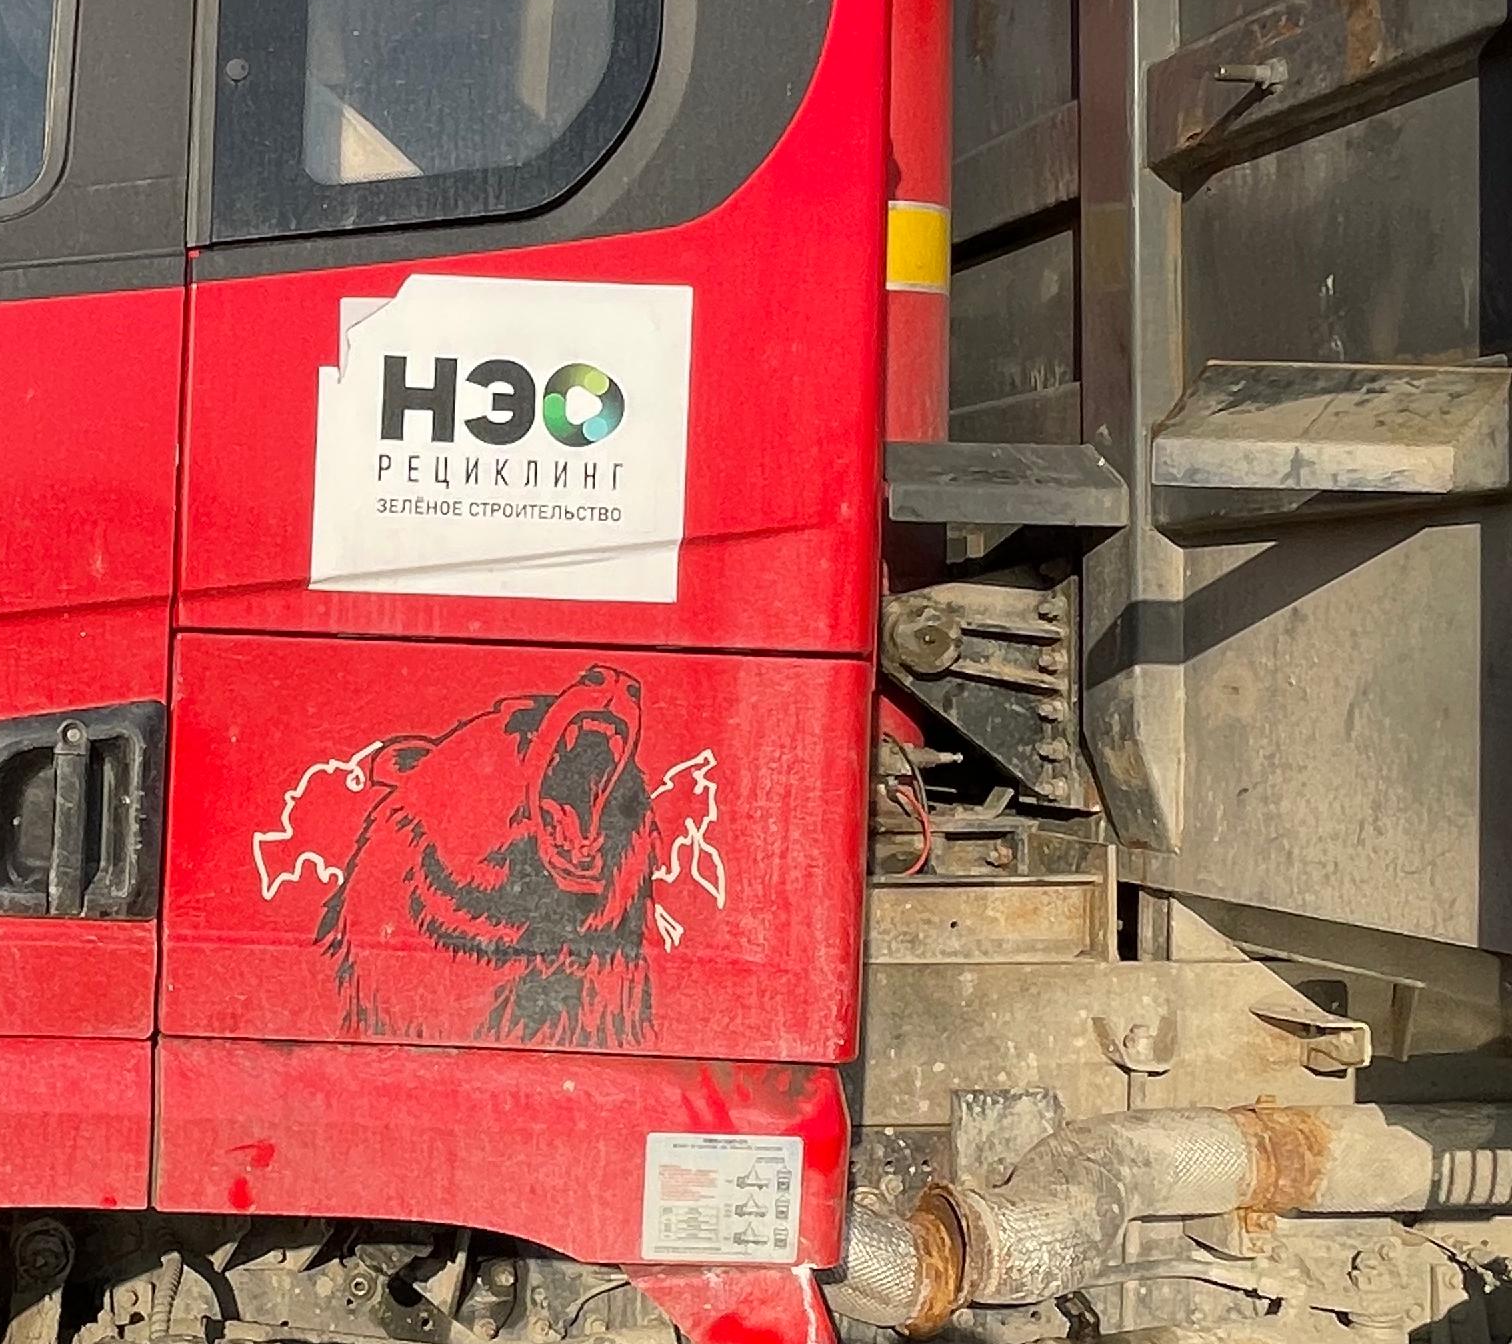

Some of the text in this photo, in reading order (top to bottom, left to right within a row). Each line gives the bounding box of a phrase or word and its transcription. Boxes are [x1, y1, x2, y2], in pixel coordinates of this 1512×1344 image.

[380, 355, 625, 447] НЭО
[377, 454, 624, 491] РЕЦИКЛИНГ
[376, 495, 622, 522] ЗЕЛЁНОЕ СТРОИТЕЛЬСТВО
